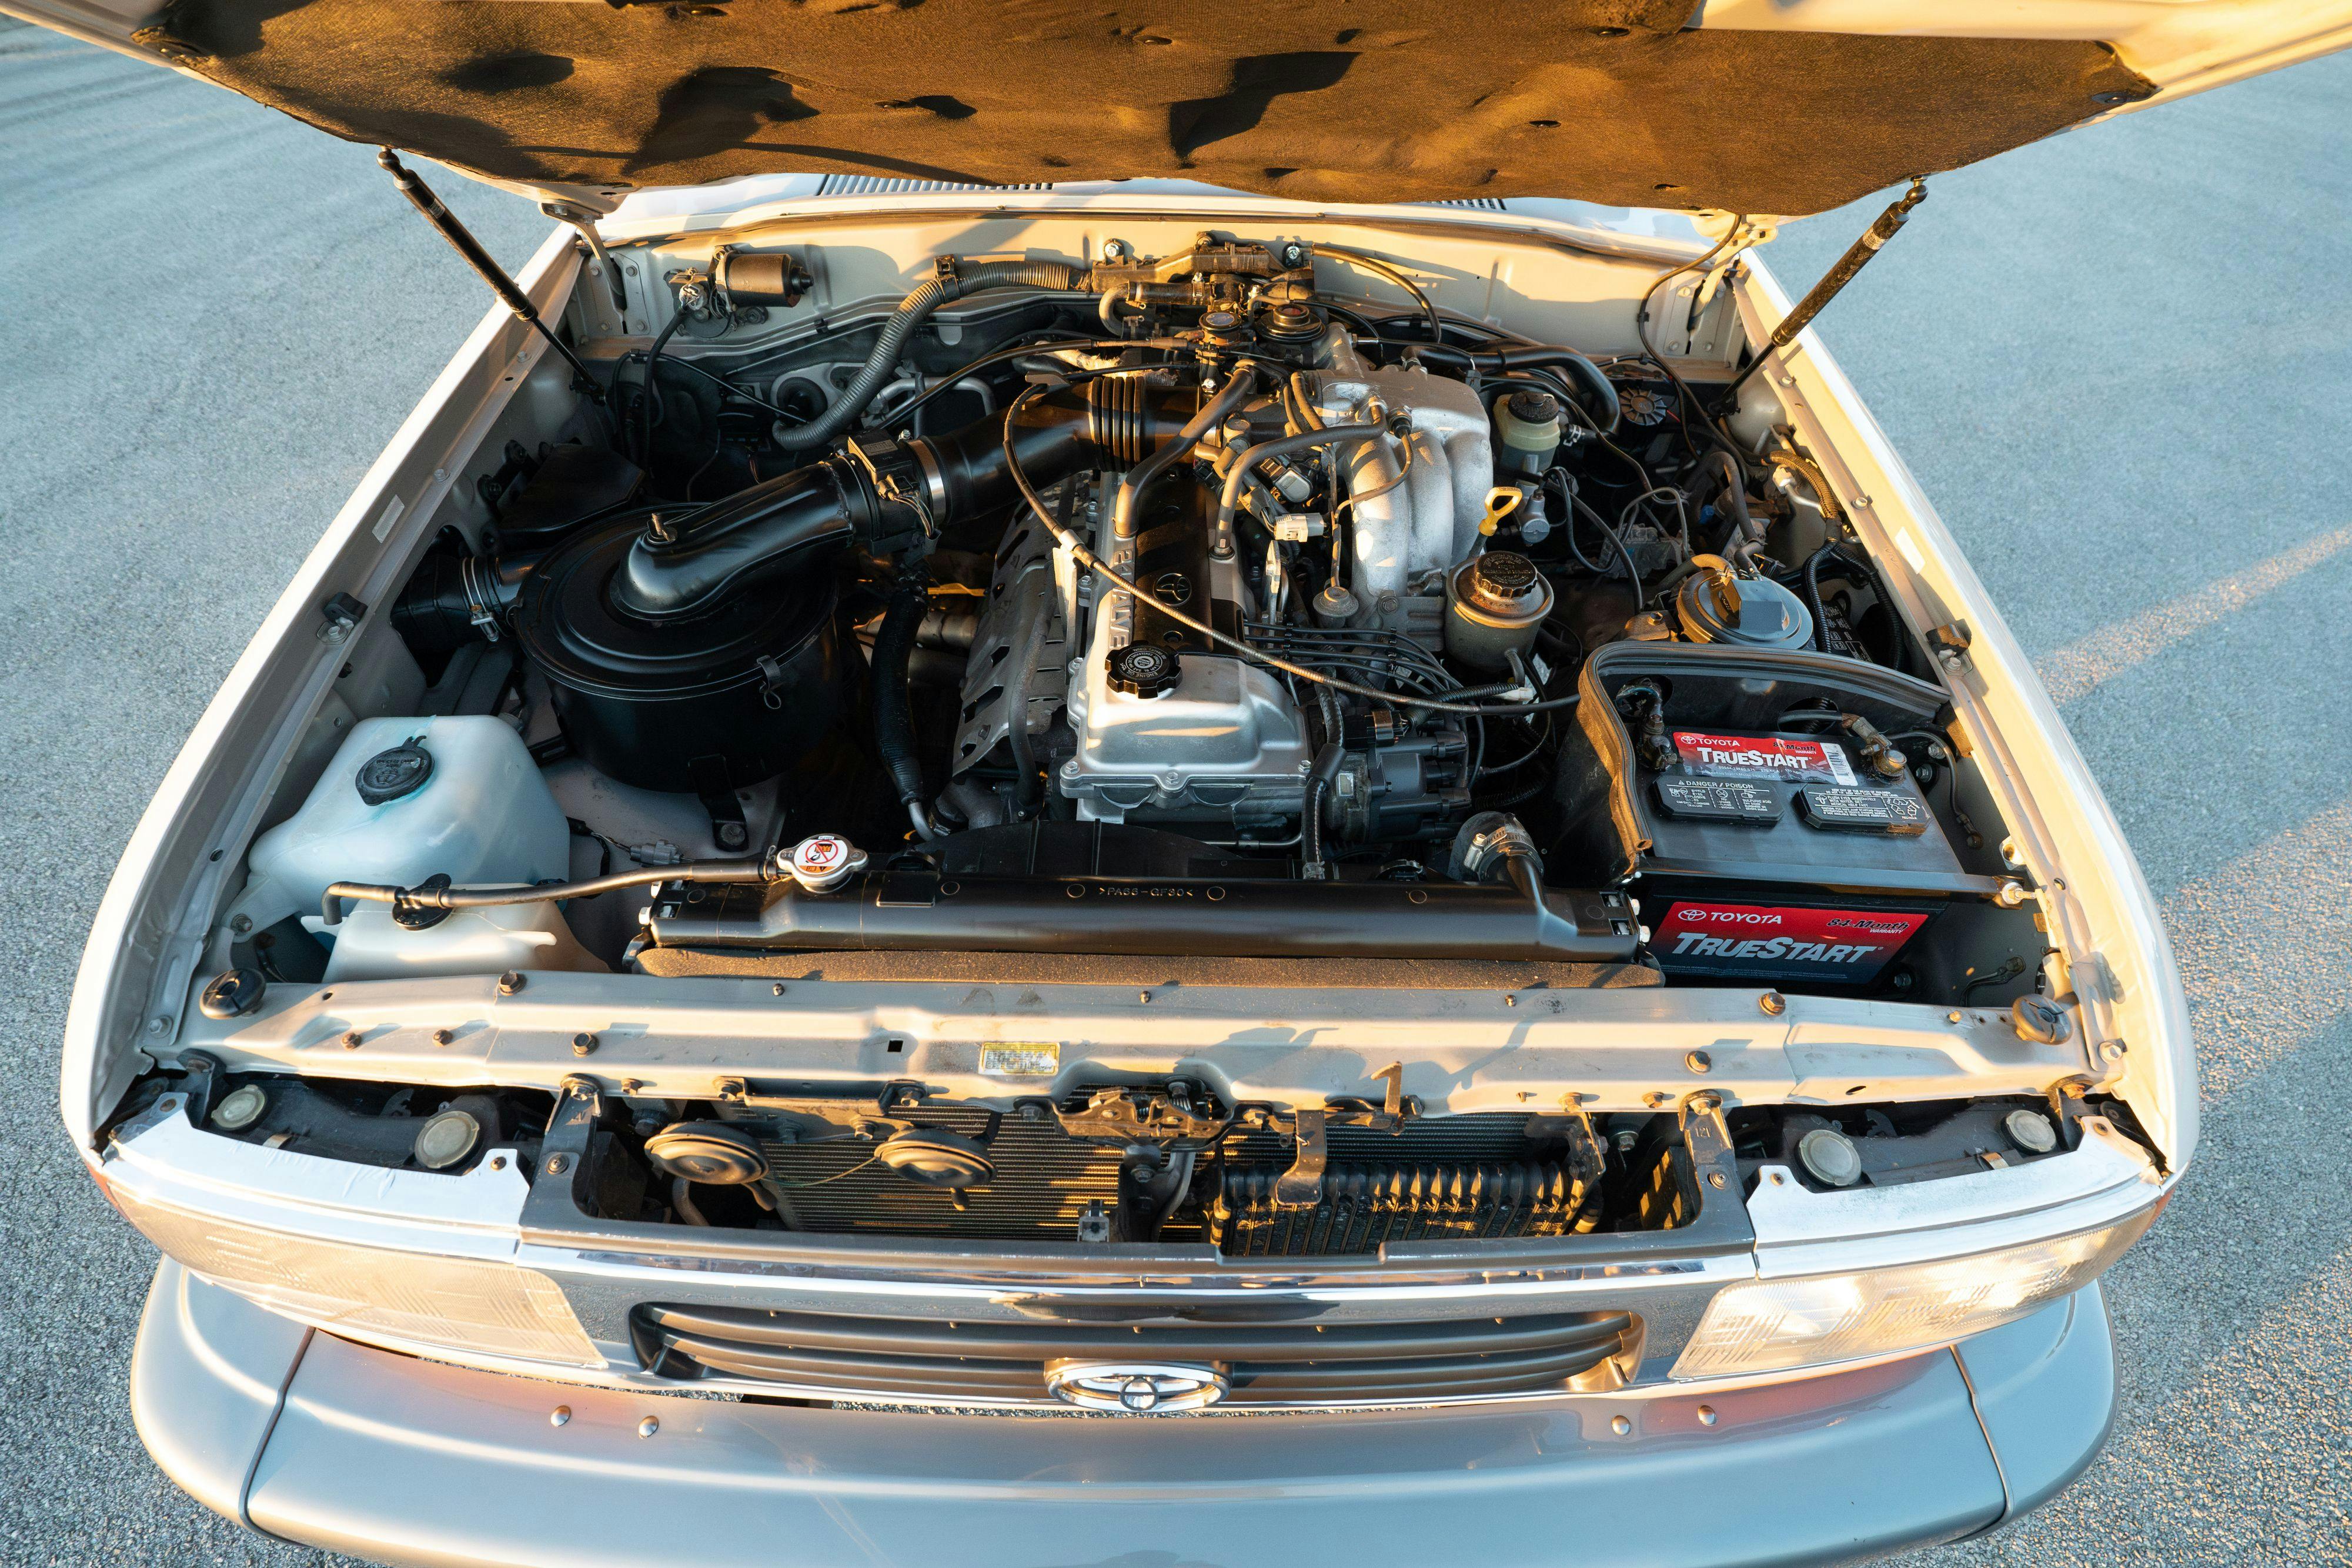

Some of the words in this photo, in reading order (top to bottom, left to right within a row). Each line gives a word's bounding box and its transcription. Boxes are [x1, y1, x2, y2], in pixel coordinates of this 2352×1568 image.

[1696, 738, 1740, 747] TOYOTA
[1710, 912, 1782, 924] TOYOTA
[1826, 918, 1909, 931] 84-Month
